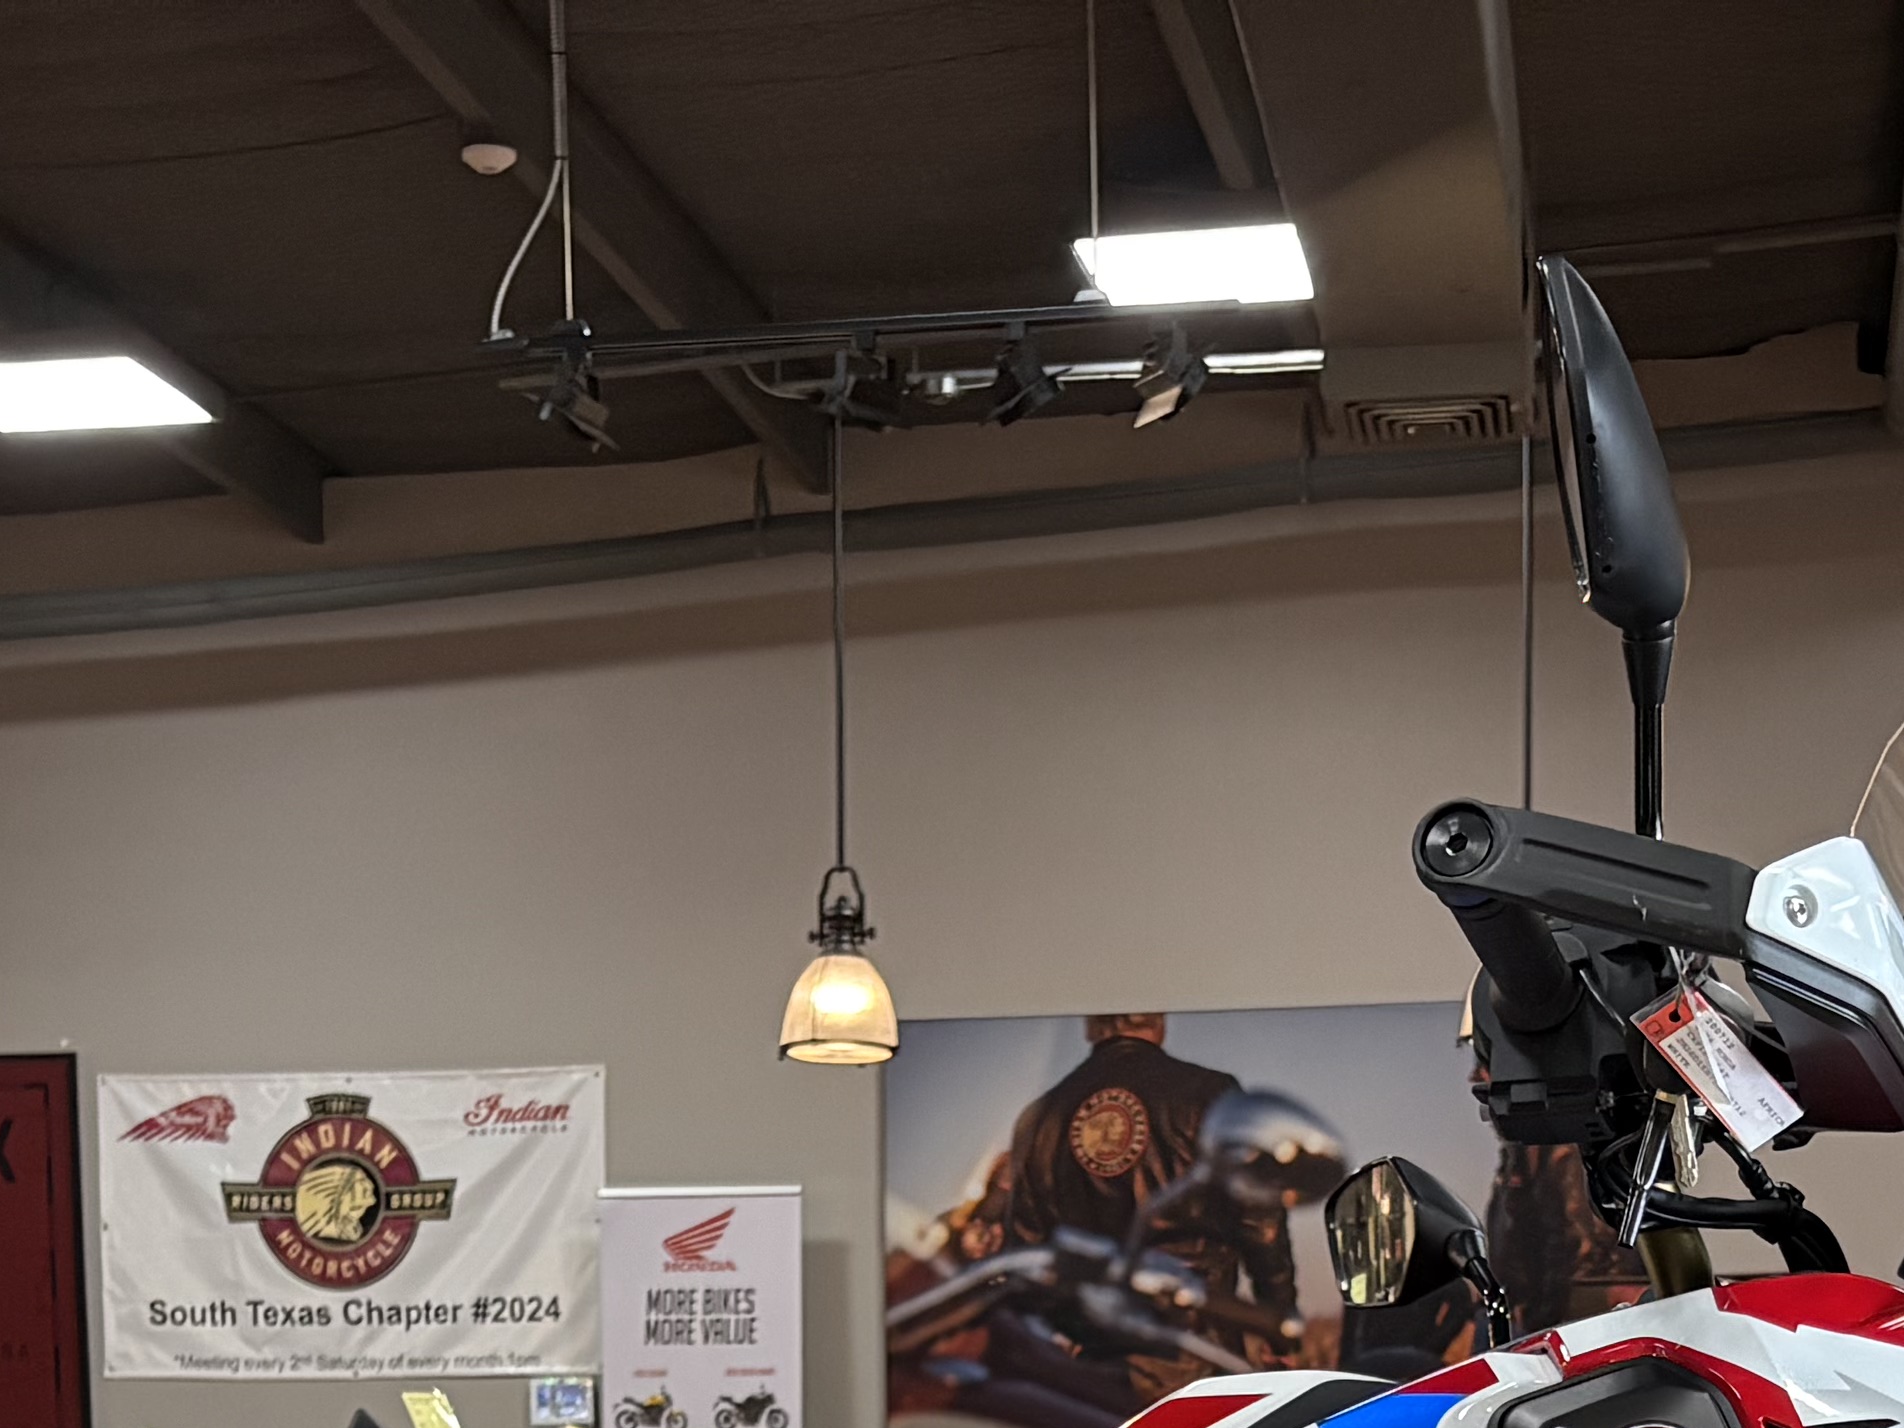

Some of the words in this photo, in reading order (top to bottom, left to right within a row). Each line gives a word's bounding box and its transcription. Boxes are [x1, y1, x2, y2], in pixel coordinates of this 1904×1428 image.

[462, 1094, 570, 1126] Indian
[279, 1121, 401, 1170] INDIAN
[231, 1193, 294, 1212] RIDERS
[390, 1191, 446, 1210] GROUP
[274, 1227, 402, 1281] MOTORCYCLE
[663, 1260, 737, 1272] HONDA
[148, 1301, 238, 1328] South
[246, 1300, 332, 1327] Texas
[342, 1298, 460, 1332] Chapter
[471, 1296, 561, 1325] #2024
[646, 1287, 696, 1315] MORE
[702, 1287, 756, 1315] BIKES
[643, 1315, 696, 1345] MORE
[700, 1316, 757, 1345] VALUE
[244, 1357, 285, 1373] every
[316, 1353, 384, 1372] Saturday
[388, 1353, 405, 1369] of
[407, 1354, 450, 1371] every
[453, 1353, 502, 1368] month
